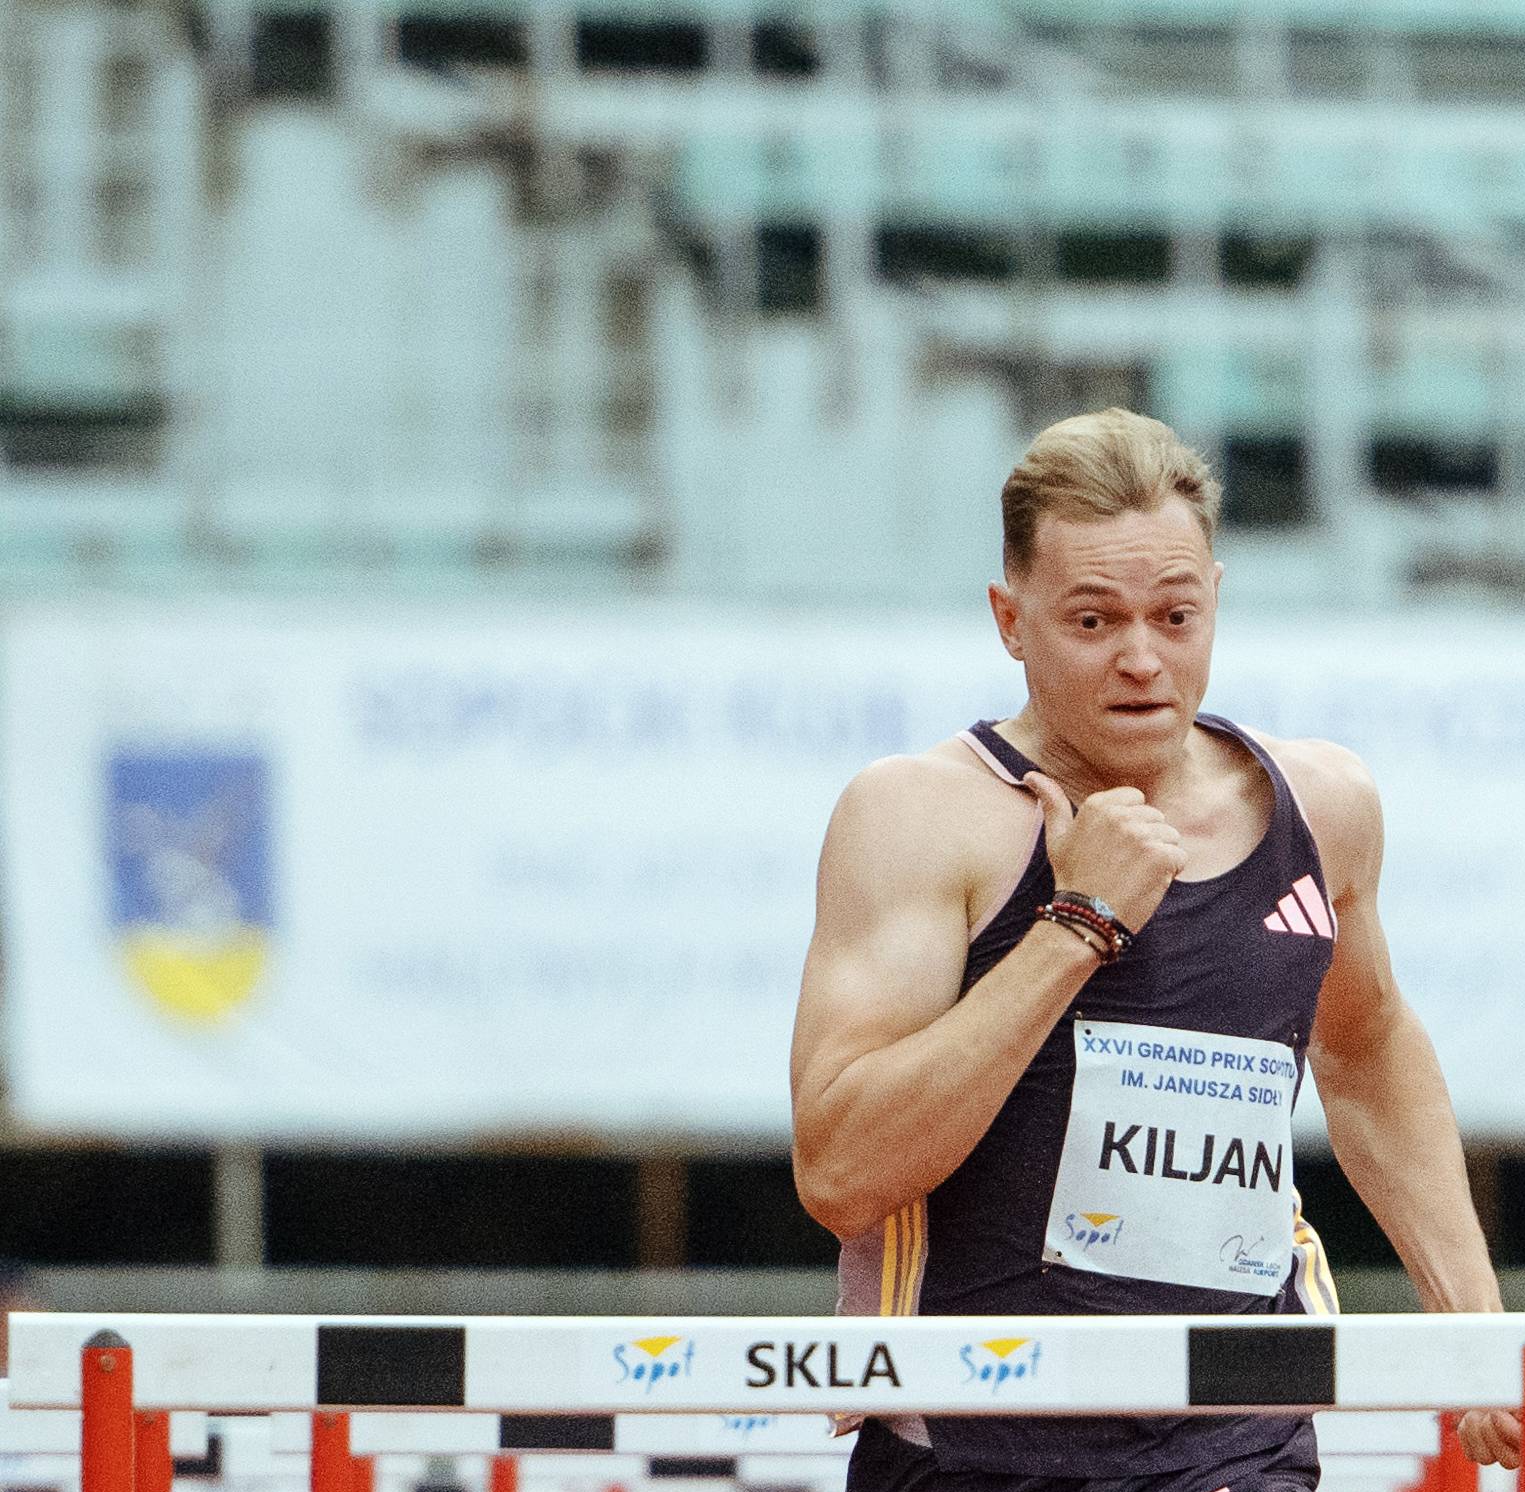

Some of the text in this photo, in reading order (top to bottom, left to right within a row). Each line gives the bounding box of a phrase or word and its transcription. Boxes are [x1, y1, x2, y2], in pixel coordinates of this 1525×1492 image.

[1083, 1037, 1133, 1056] XXVI
[1138, 1042, 1206, 1065] GRAND
[1211, 1051, 1255, 1072] PRIX
[1121, 1070, 1148, 1089] IM.
[1153, 1074, 1243, 1101] JANUSZA
[1099, 1121, 1283, 1193] KILJAN
[1066, 1213, 1125, 1252] Sopot
[612, 1340, 1042, 1394] Sopot SKLA Sopot
